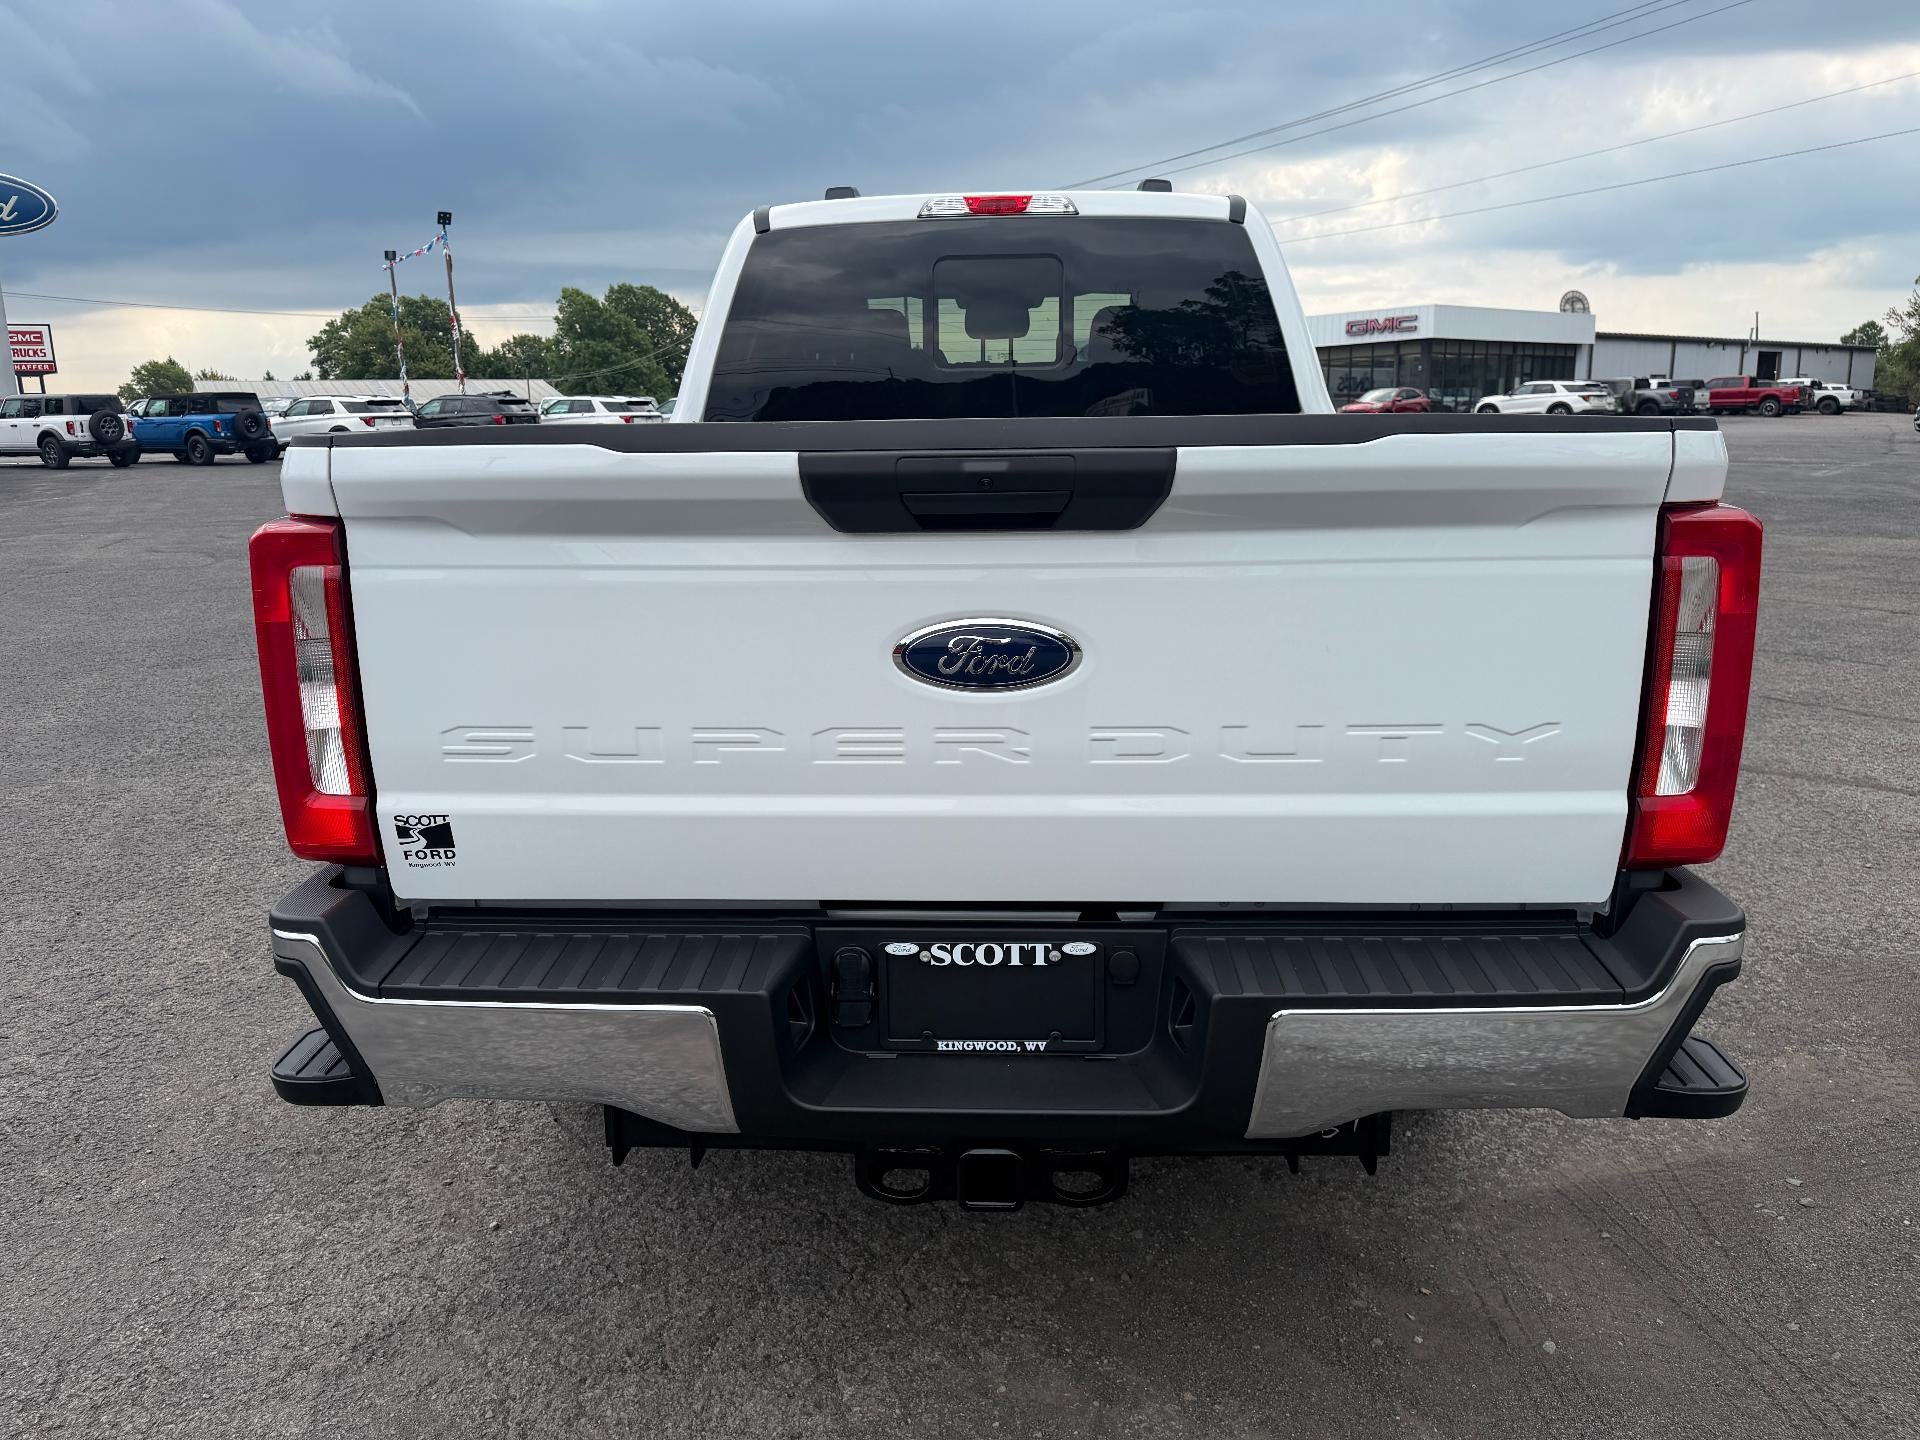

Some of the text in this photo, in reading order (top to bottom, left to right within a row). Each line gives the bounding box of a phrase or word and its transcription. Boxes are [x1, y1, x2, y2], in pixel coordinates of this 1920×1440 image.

[1345, 315, 1418, 337] GMC
[8, 333, 42, 342] GMC
[12, 347, 47, 358] RUCKS
[937, 635, 1038, 675] Ford
[440, 722, 1563, 764] SUPER DUTY
[393, 814, 450, 827] SCOTT
[403, 849, 457, 861] FORD
[930, 943, 1052, 966] SCOTT
[936, 1040, 1048, 1053] KINGWOOD, WV
